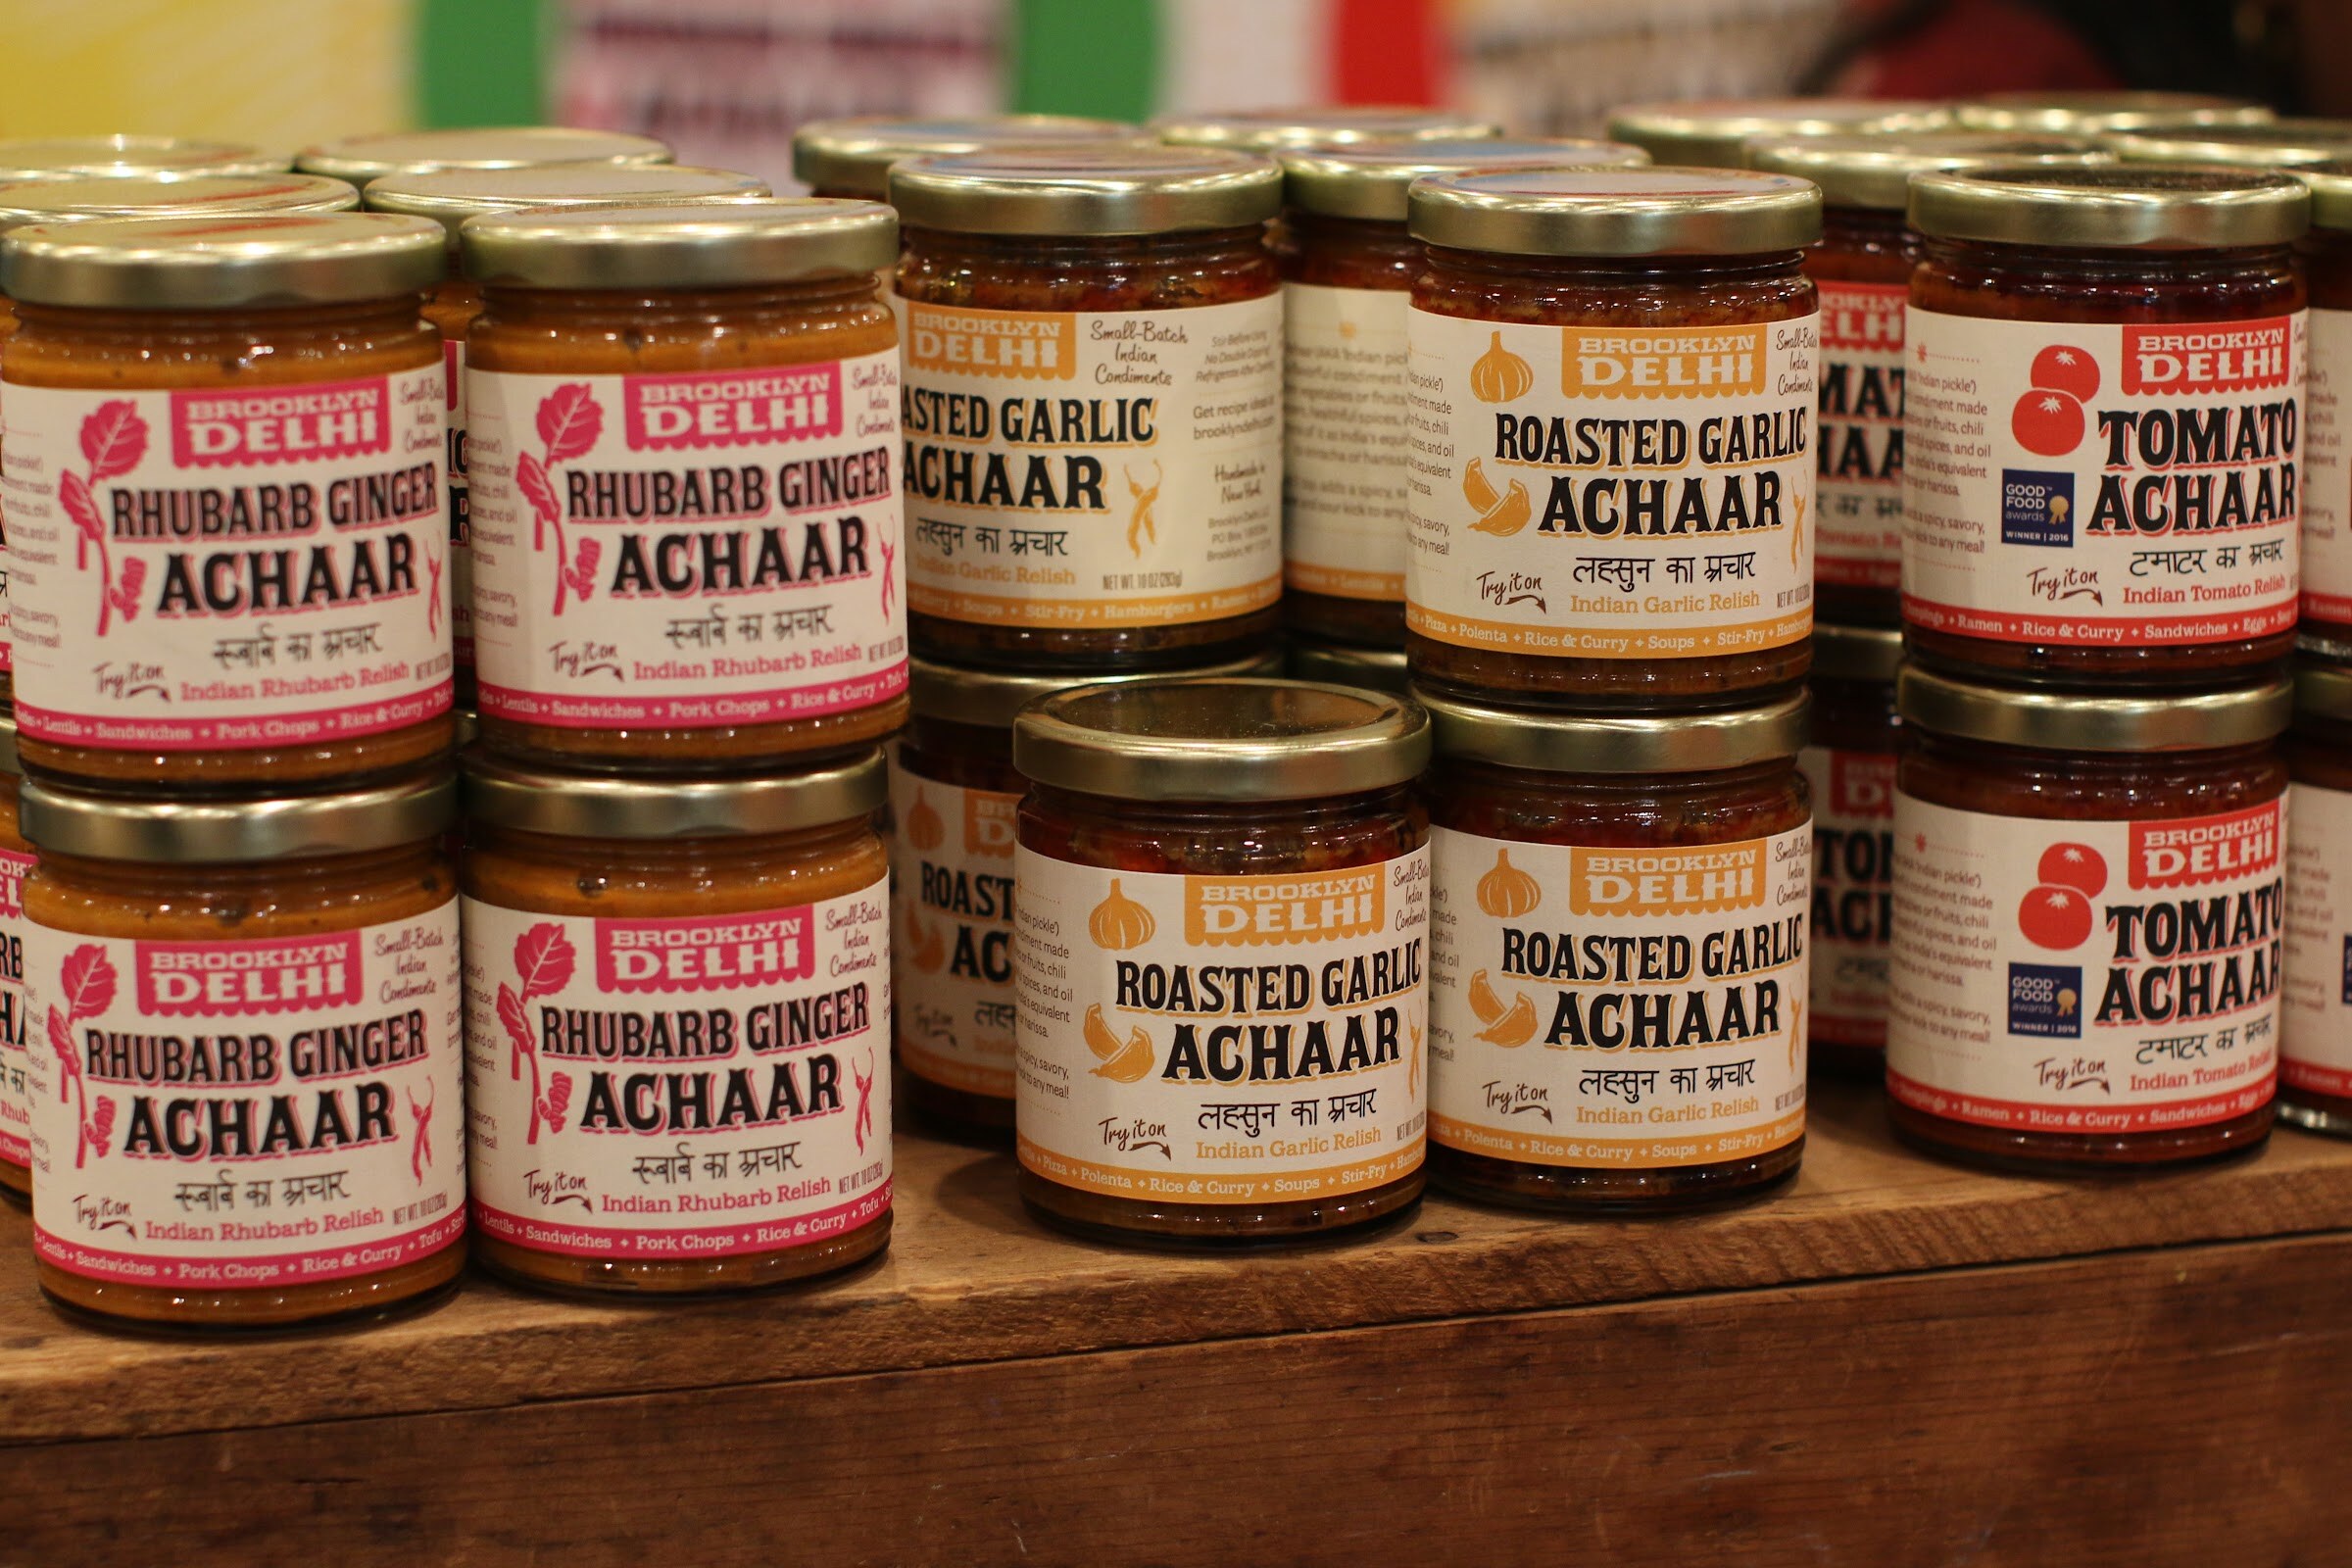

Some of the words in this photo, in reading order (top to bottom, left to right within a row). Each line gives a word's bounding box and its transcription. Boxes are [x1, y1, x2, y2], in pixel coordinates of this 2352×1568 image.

[914, 313, 1061, 337] BROOKLYN
[1091, 320, 1188, 344] Small-Batch
[2139, 328, 2283, 351] BROOKLYN
[914, 330, 1058, 368] DELHI
[1115, 344, 1157, 364] Indian
[1578, 335, 1755, 353] BROOKLYN
[1096, 366, 1171, 385] Condiments
[1577, 356, 1753, 386] DELHI
[2139, 351, 2282, 382] DELHI
[641, 373, 830, 401] BROOKLYN
[186, 389, 377, 417] BROOKLYN
[641, 396, 828, 437] DELHI
[902, 389, 989, 440] ASTED
[1002, 398, 1153, 443] GARLIC
[1957, 402, 1987, 416] made
[187, 411, 378, 454] DELHI
[1495, 414, 1686, 466] ROASTED
[1698, 407, 1806, 466] GARLIC
[1961, 421, 1984, 435] chili
[2099, 398, 2297, 466] TOMATO
[1955, 444, 1974, 456] and
[1978, 445, 1990, 457] oil
[566, 465, 766, 518] RHUBARB
[779, 447, 889, 508] GINGER
[904, 446, 1105, 509] ACHAAR
[111, 483, 316, 535] RHUBARB
[328, 462, 438, 525] GINGER
[1538, 471, 1781, 535] ACHAAR
[2007, 497, 2044, 510] FOOD
[2087, 462, 2294, 532] ACHAAR
[2006, 509, 2044, 521] awards
[2007, 531, 2041, 540] WINNER
[2049, 532, 2069, 541] 2016
[612, 516, 868, 593] ACHAAR
[157, 532, 416, 612] ACHAAR
[1017, 568, 1075, 585] Relish
[2028, 567, 2061, 600] Try
[2063, 567, 2077, 584] it
[2080, 570, 2098, 584] on
[1477, 571, 1507, 605] Try
[1509, 573, 1521, 591] it
[1523, 574, 1542, 590] on
[1571, 595, 1640, 613] Indian
[1644, 594, 1704, 612] Garlic
[1709, 591, 1760, 610] Relish
[2124, 587, 2186, 604] Indian
[2191, 584, 2251, 603] Tomato
[2255, 576, 2285, 595] Relish
[1026, 605, 1085, 621] Stir-Fry
[1104, 602, 1195, 619] Hamburgers
[1460, 623, 1507, 643] Polenta
[1525, 631, 1558, 646] Rice
[1581, 635, 1628, 651] Curry
[1648, 636, 1694, 651] Soups
[1717, 628, 1765, 646] Stir-Fry
[1959, 616, 2002, 632] Ramen
[2023, 621, 2055, 636] Rice
[2078, 624, 2124, 641] Curry
[2145, 622, 2229, 639] Sandwiches
[635, 662, 709, 680] Indian
[713, 652, 805, 677] Rhubarb
[810, 644, 861, 669] Relish
[2144, 811, 2274, 847] BROOKLYN
[1587, 851, 1756, 872] BROOKLYN
[2143, 834, 2273, 876] DELHI
[1200, 875, 1375, 902] BROOKLYN
[1405, 885, 1423, 906] Indian
[1587, 872, 1753, 904] DELHI
[826, 901, 881, 931] Small-Batch
[1200, 900, 1373, 934] DELHI
[2106, 876, 2281, 958] TOMATO
[375, 927, 444, 956] Small-Batch
[612, 918, 802, 946] BROOKLYN
[843, 931, 869, 949] Indian
[1503, 928, 1690, 981] ROASTED
[1702, 913, 1802, 976] GARLIC
[150, 944, 348, 969] BROOKLYN
[396, 955, 427, 975] Indian
[612, 939, 800, 980] DELHI
[830, 954, 877, 977] Condiments
[1045, 943, 1069, 958] made
[153, 966, 345, 1003] DELHI
[1048, 963, 1066, 979] chili
[1116, 959, 1309, 1013] ROASTED
[1322, 938, 1421, 1006] GARLIC
[380, 979, 437, 1003] Condiments
[1044, 986, 1058, 1000] and
[1061, 989, 1072, 1002] oil
[2013, 989, 2053, 1003] FOOD
[542, 1005, 734, 1057] RHUBARB
[748, 982, 868, 1052] GINGER
[1544, 979, 1779, 1048] ACHAAR
[87, 1029, 273, 1082] RHUBARB
[290, 1009, 427, 1076] GINGER
[1161, 1006, 1400, 1082] ACHAAR
[581, 1053, 842, 1131] ACHAAR
[2131, 1073, 2187, 1092] Indian
[2193, 1064, 2246, 1087] Tomato
[124, 1082, 395, 1155] ACHAAR
[1576, 1106, 1643, 1124] Indian
[1648, 1102, 1707, 1123] Garlic
[1712, 1097, 1759, 1117] Relish
[1099, 1117, 1129, 1151] Try
[1132, 1120, 1145, 1136] it
[1148, 1122, 1166, 1137] on
[1196, 1141, 1264, 1159] Indian
[1270, 1136, 1329, 1157] Garlic
[1334, 1127, 1382, 1150] Relish
[1465, 1129, 1512, 1150] Polenta
[1651, 1144, 1697, 1158] Soups
[524, 1170, 552, 1202] Try
[554, 1174, 564, 1192] it
[566, 1176, 587, 1192] on
[1043, 1154, 1067, 1175] Pizza
[1081, 1168, 1132, 1189] Polenta
[1150, 1178, 1183, 1192] Rice
[1188, 1180, 1202, 1194] &
[1207, 1181, 1253, 1197] Curry
[1275, 1177, 1320, 1193] Soups
[1343, 1164, 1387, 1185] Stir-Fry
[603, 1194, 671, 1213] Indian
[679, 1187, 771, 1212] Rhubarb
[777, 1178, 831, 1201] Relish
[146, 1220, 213, 1239] Indian
[221, 1213, 318, 1241] Rhubarb
[325, 1208, 383, 1232] Relish
[485, 1213, 514, 1235] Lentils
[526, 1229, 612, 1249] Sandwiches
[637, 1235, 678, 1250] Pork
[682, 1233, 734, 1251] Chops
[758, 1228, 791, 1243] Rice
[795, 1223, 807, 1236] &
[810, 1213, 848, 1235] Curry
[860, 1198, 879, 1217] Tofu
[75, 1251, 156, 1276] Sandwiches
[178, 1263, 220, 1278] Pork
[225, 1261, 279, 1281] Chops
